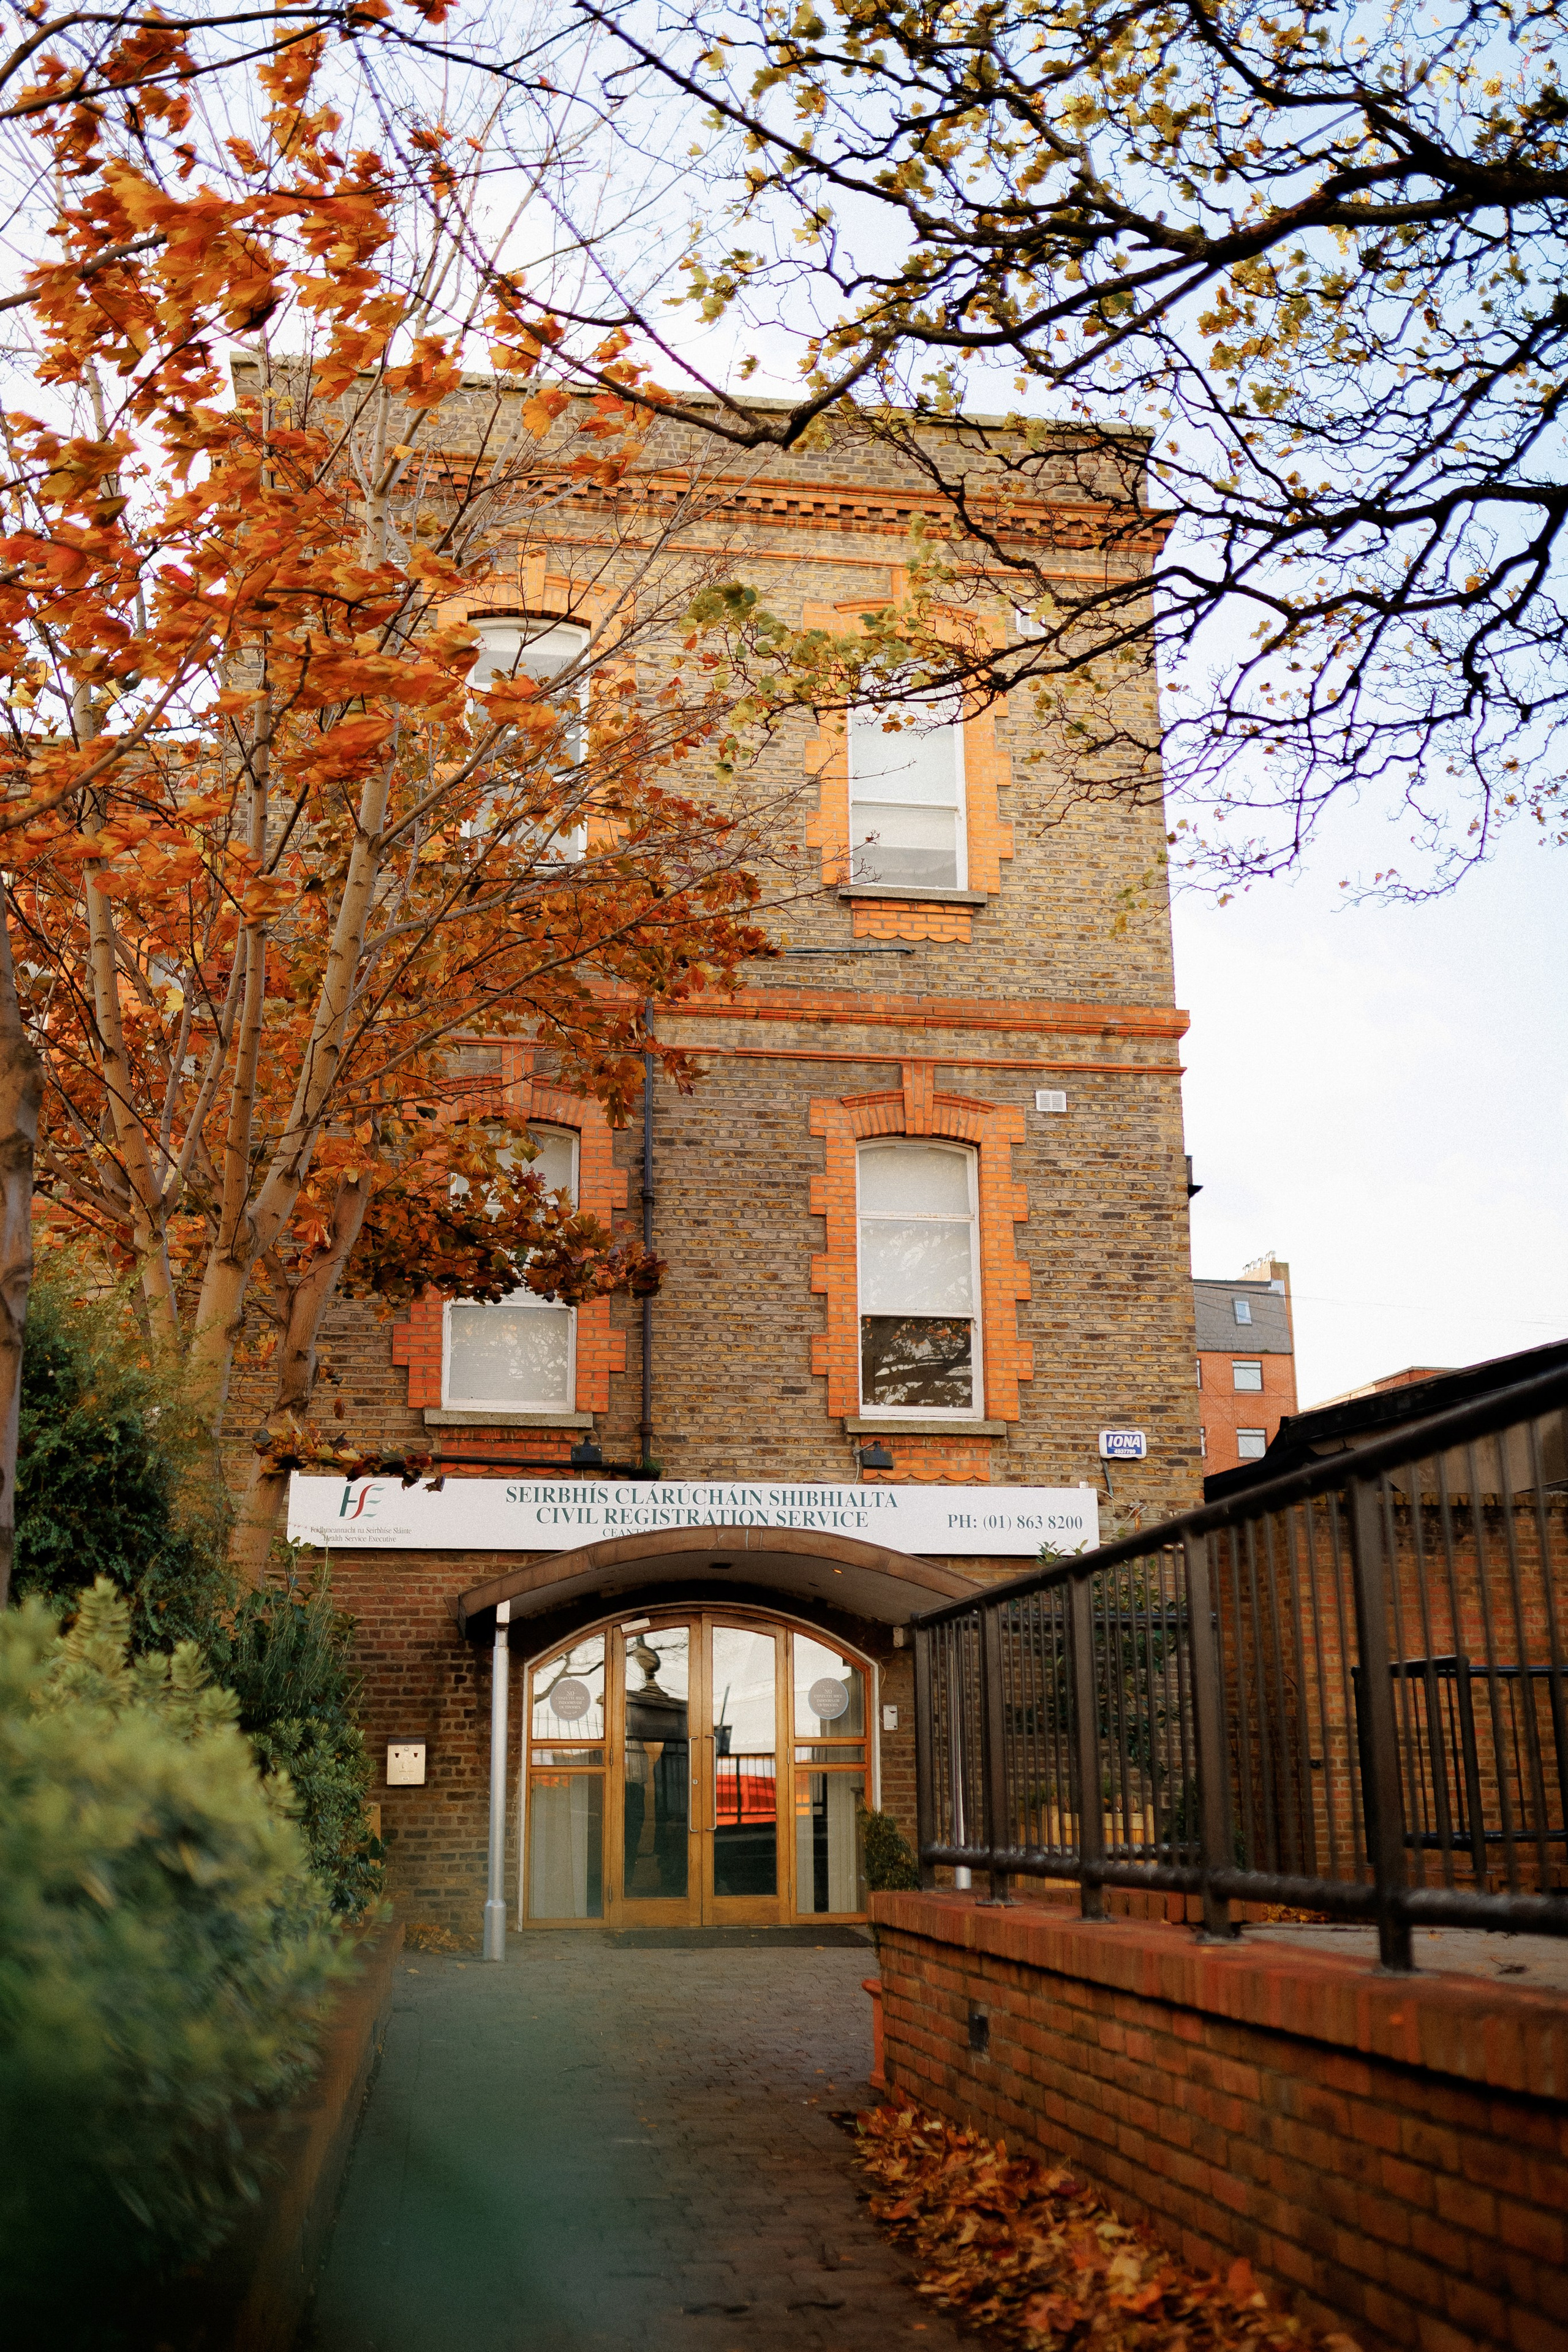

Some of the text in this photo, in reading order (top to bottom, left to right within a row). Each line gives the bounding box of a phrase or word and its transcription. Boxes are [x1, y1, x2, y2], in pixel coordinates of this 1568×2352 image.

[1108, 1435, 1140, 1448] IONA
[506, 1482, 899, 1508] SEIRBHÍS CLÁRÚCHÁIN SHIBHIALTA
[536, 1507, 869, 1528] CIVIL REGISTRATION SERVICE
[948, 1514, 1083, 1531] PH: (01) 863 8200
